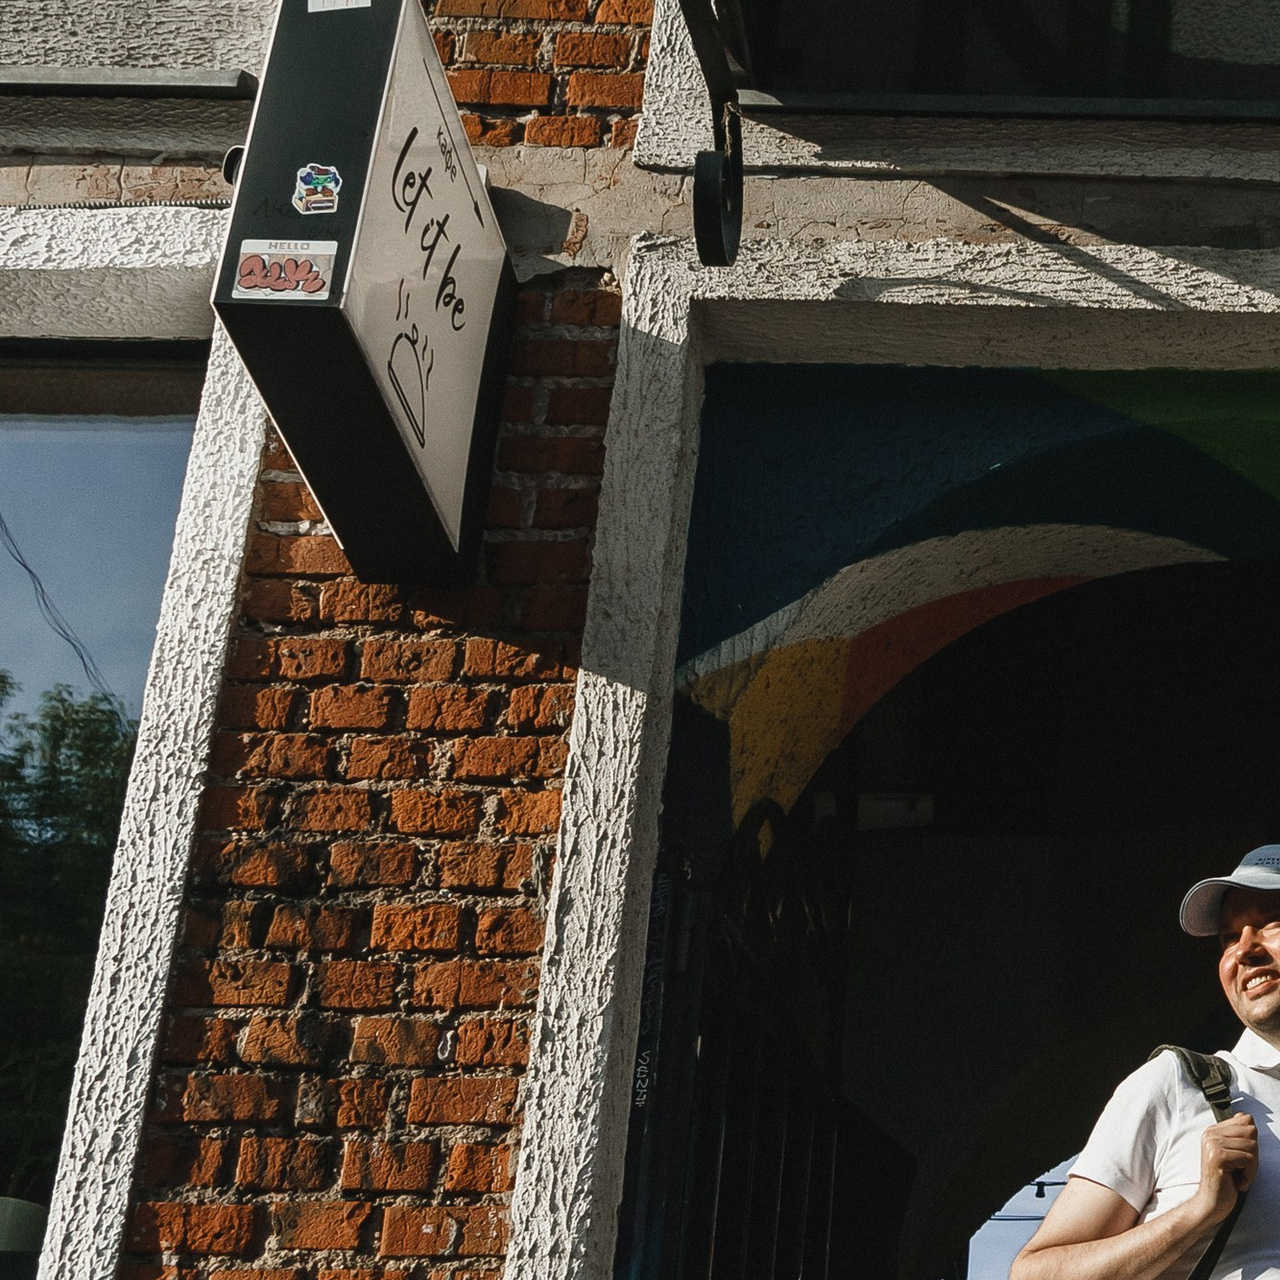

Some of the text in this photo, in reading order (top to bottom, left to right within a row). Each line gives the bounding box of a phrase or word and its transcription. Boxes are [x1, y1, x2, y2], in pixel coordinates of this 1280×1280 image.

[437, 125, 457, 183] кафе
[268, 241, 310, 251] HELLO
[391, 126, 467, 331] let it be
